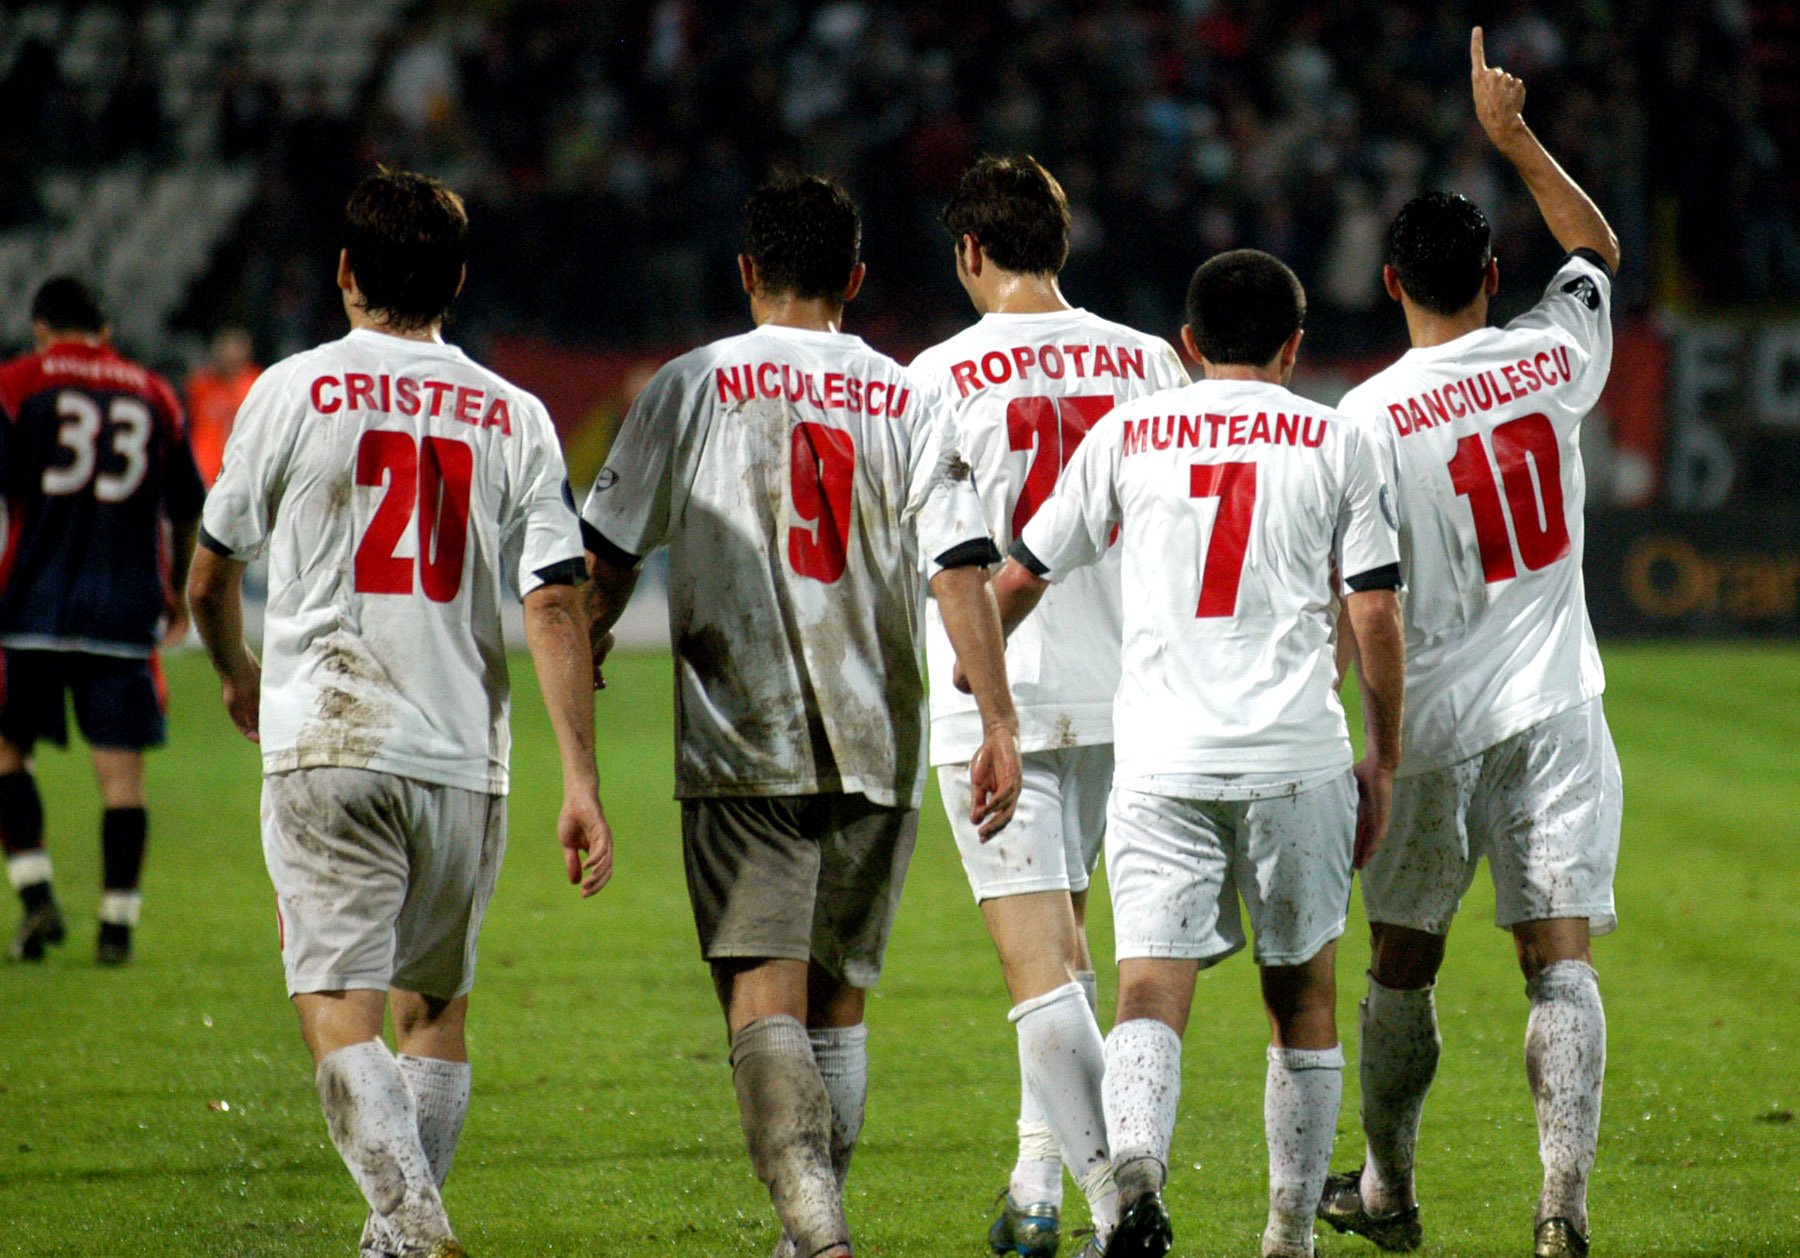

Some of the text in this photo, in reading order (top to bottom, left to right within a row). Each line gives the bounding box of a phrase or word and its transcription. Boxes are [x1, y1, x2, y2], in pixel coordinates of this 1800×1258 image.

[311, 373, 512, 436] CRISTEA
[716, 362, 910, 418] NICULESCU
[951, 345, 1147, 398] ROPOTAN
[1388, 345, 1573, 437] DANCIULESCU
[41, 391, 152, 501] 33
[1123, 412, 1328, 457] MUNTEANU
[354, 429, 474, 603] 20
[787, 421, 856, 584] 9
[1190, 461, 1257, 618] 7
[1447, 412, 1571, 584] 10
